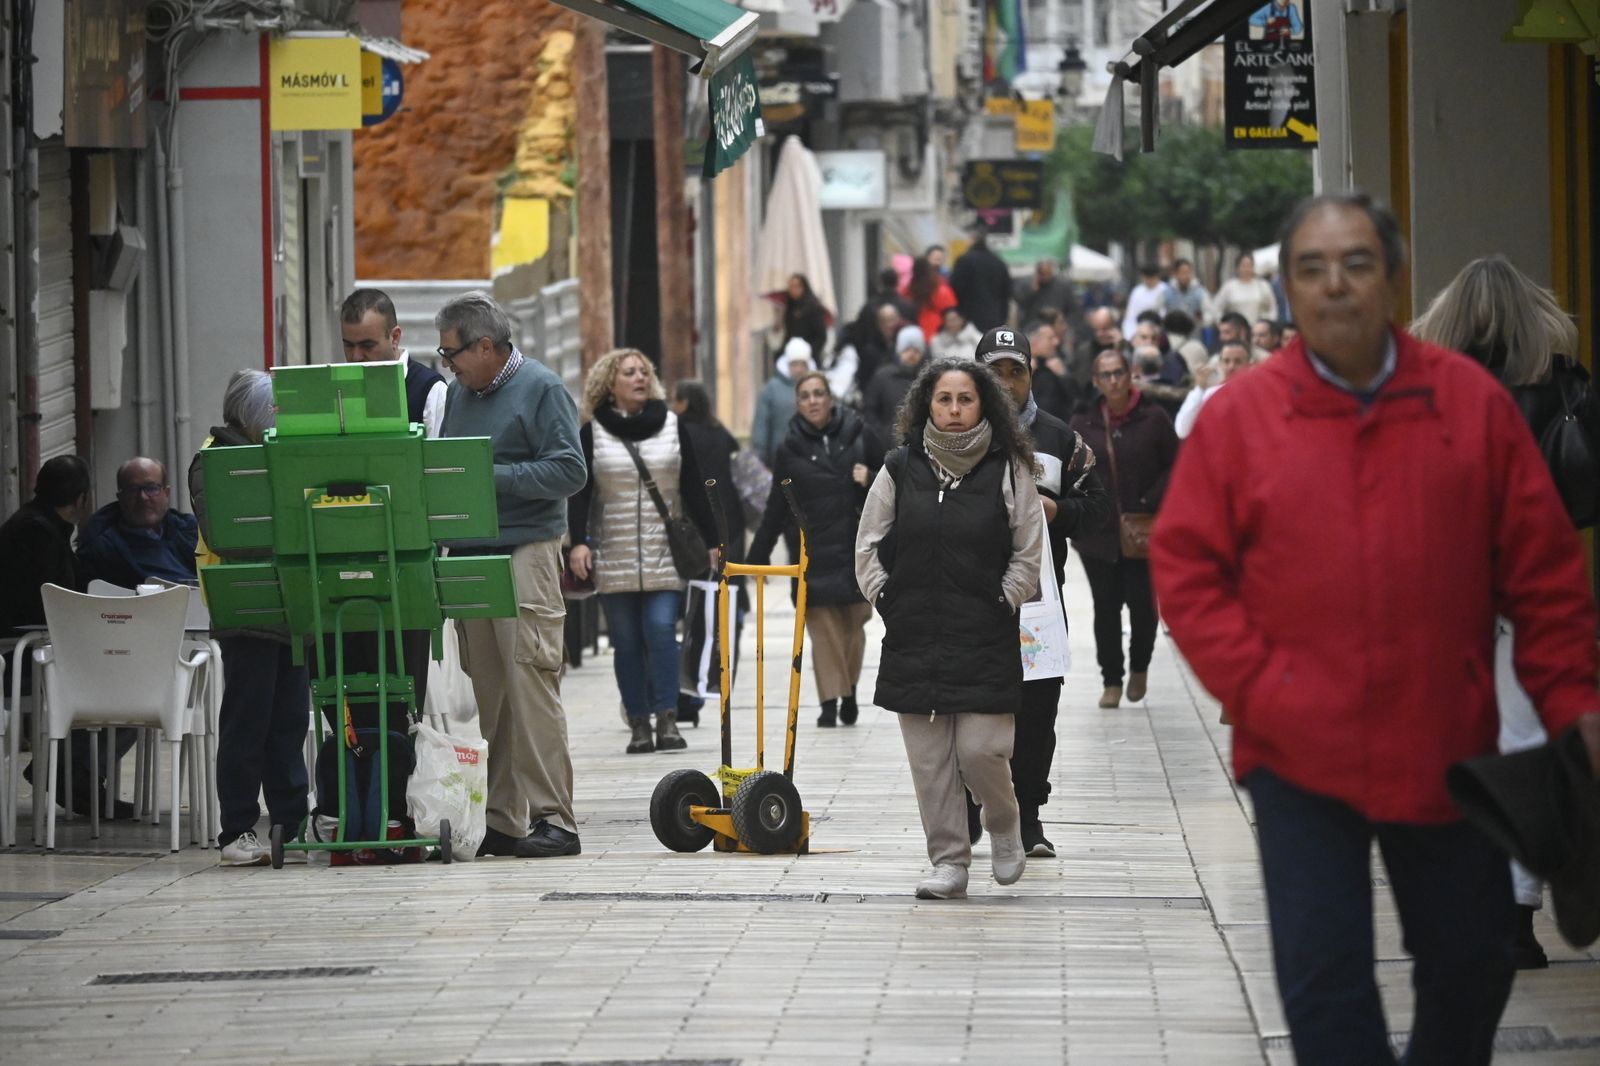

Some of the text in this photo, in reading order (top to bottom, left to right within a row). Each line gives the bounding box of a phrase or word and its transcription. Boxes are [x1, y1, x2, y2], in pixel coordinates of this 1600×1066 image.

[1235, 41, 1252, 51] EL
[281, 71, 349, 88] MÁSMÓVIL
[1233, 126, 1247, 138] EN
